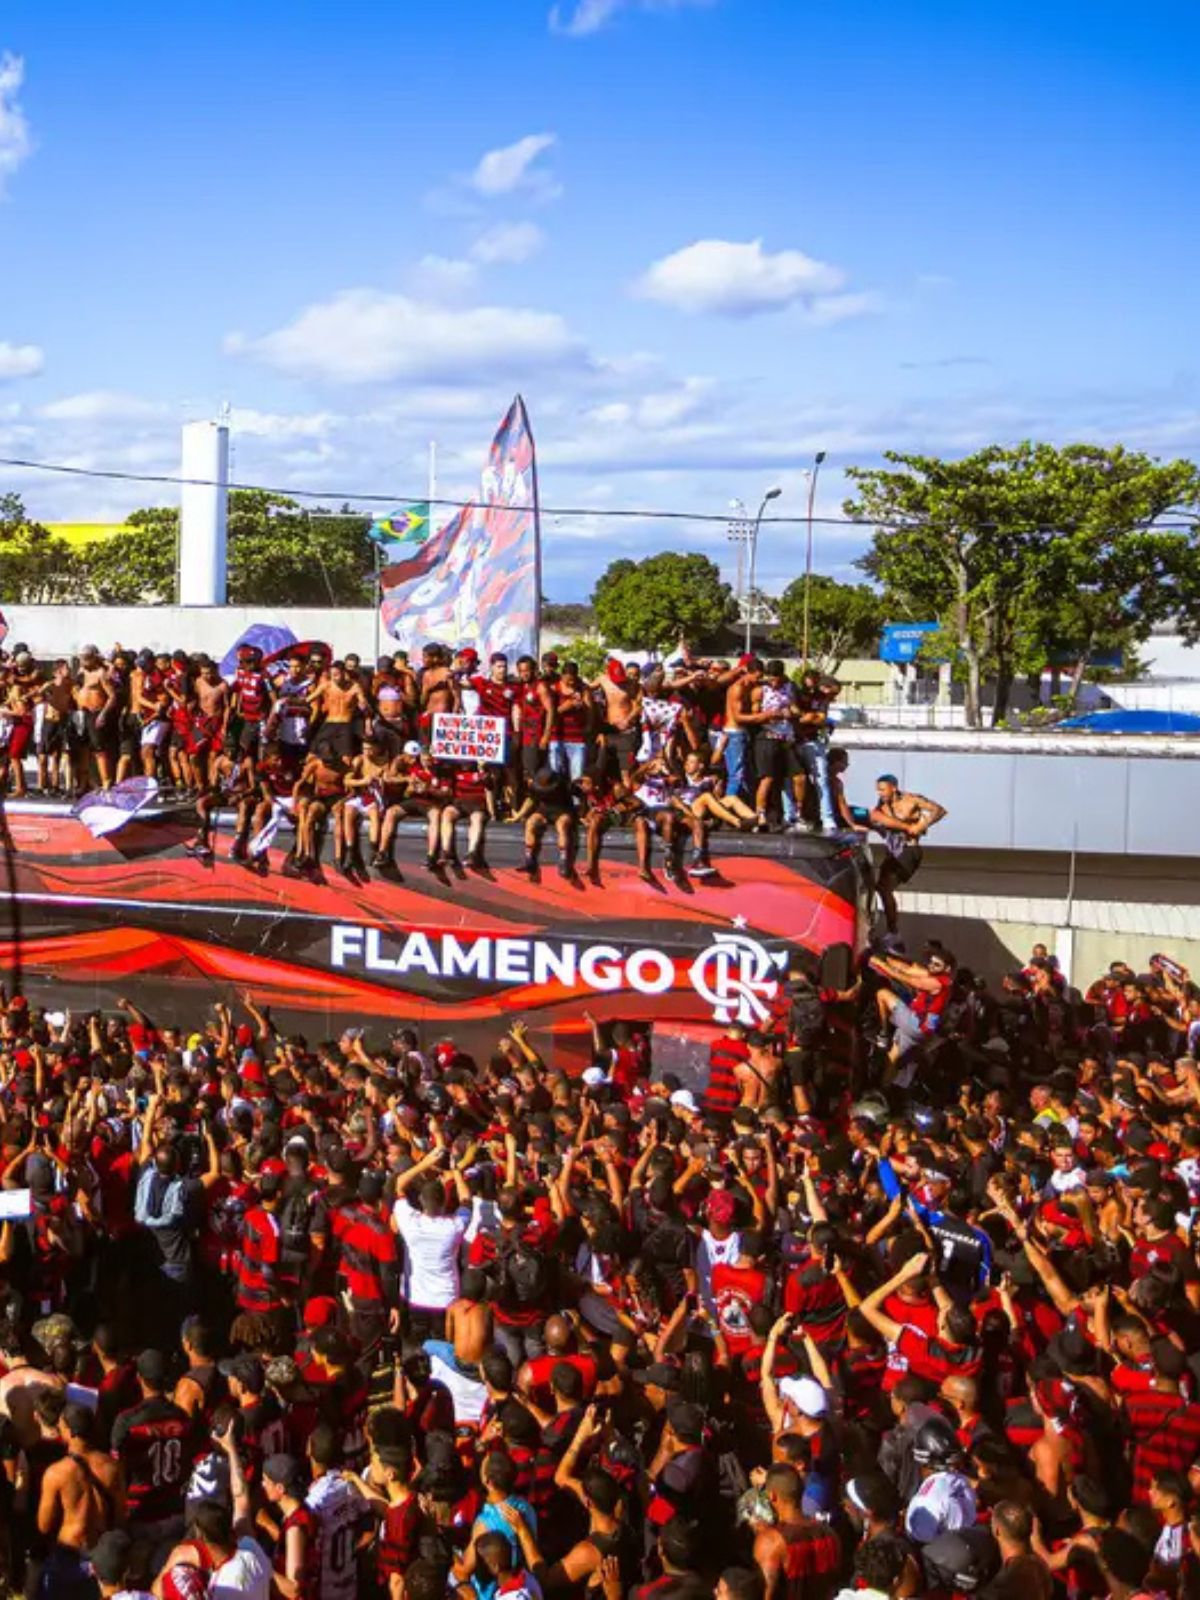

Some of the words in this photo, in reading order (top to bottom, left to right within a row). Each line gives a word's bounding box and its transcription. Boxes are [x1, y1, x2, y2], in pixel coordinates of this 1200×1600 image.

[436, 729, 476, 743] MORRE
[477, 732, 501, 746] NOS
[330, 925, 675, 994] FLAMENGO
